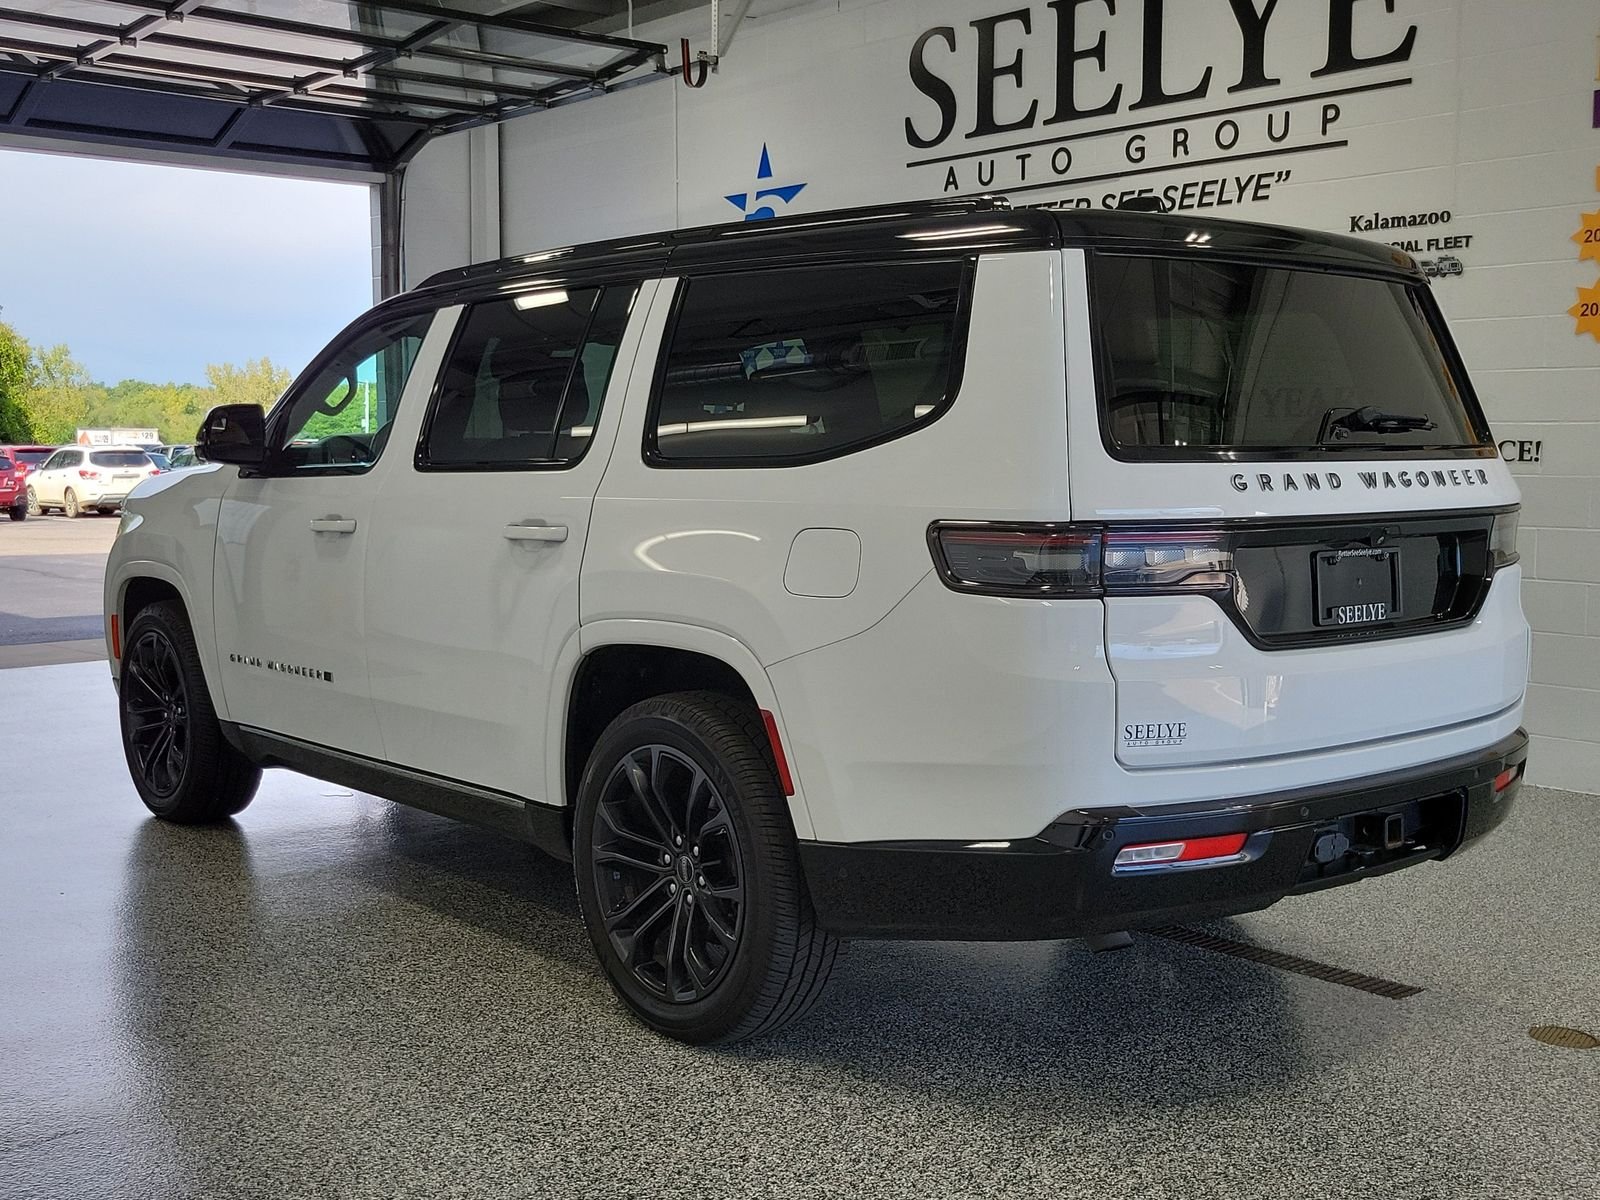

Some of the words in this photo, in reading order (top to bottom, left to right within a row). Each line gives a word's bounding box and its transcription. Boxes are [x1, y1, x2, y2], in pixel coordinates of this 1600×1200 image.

[944, 147, 1073, 193] AUTO
[1125, 103, 1342, 164] GROUP
[1349, 210, 1451, 233] Kalamazoo
[1384, 239, 1423, 253] IAL
[1426, 234, 1473, 252] FLEET
[1580, 302, 1600, 317] 20
[1230, 473, 1342, 493] GRAND
[1357, 468, 1489, 490] WAGONEER
[1338, 602, 1387, 625] SEELYE
[229, 653, 262, 668] GRAND
[267, 660, 323, 680] WAGONEER
[1123, 722, 1187, 740] SEELYE
